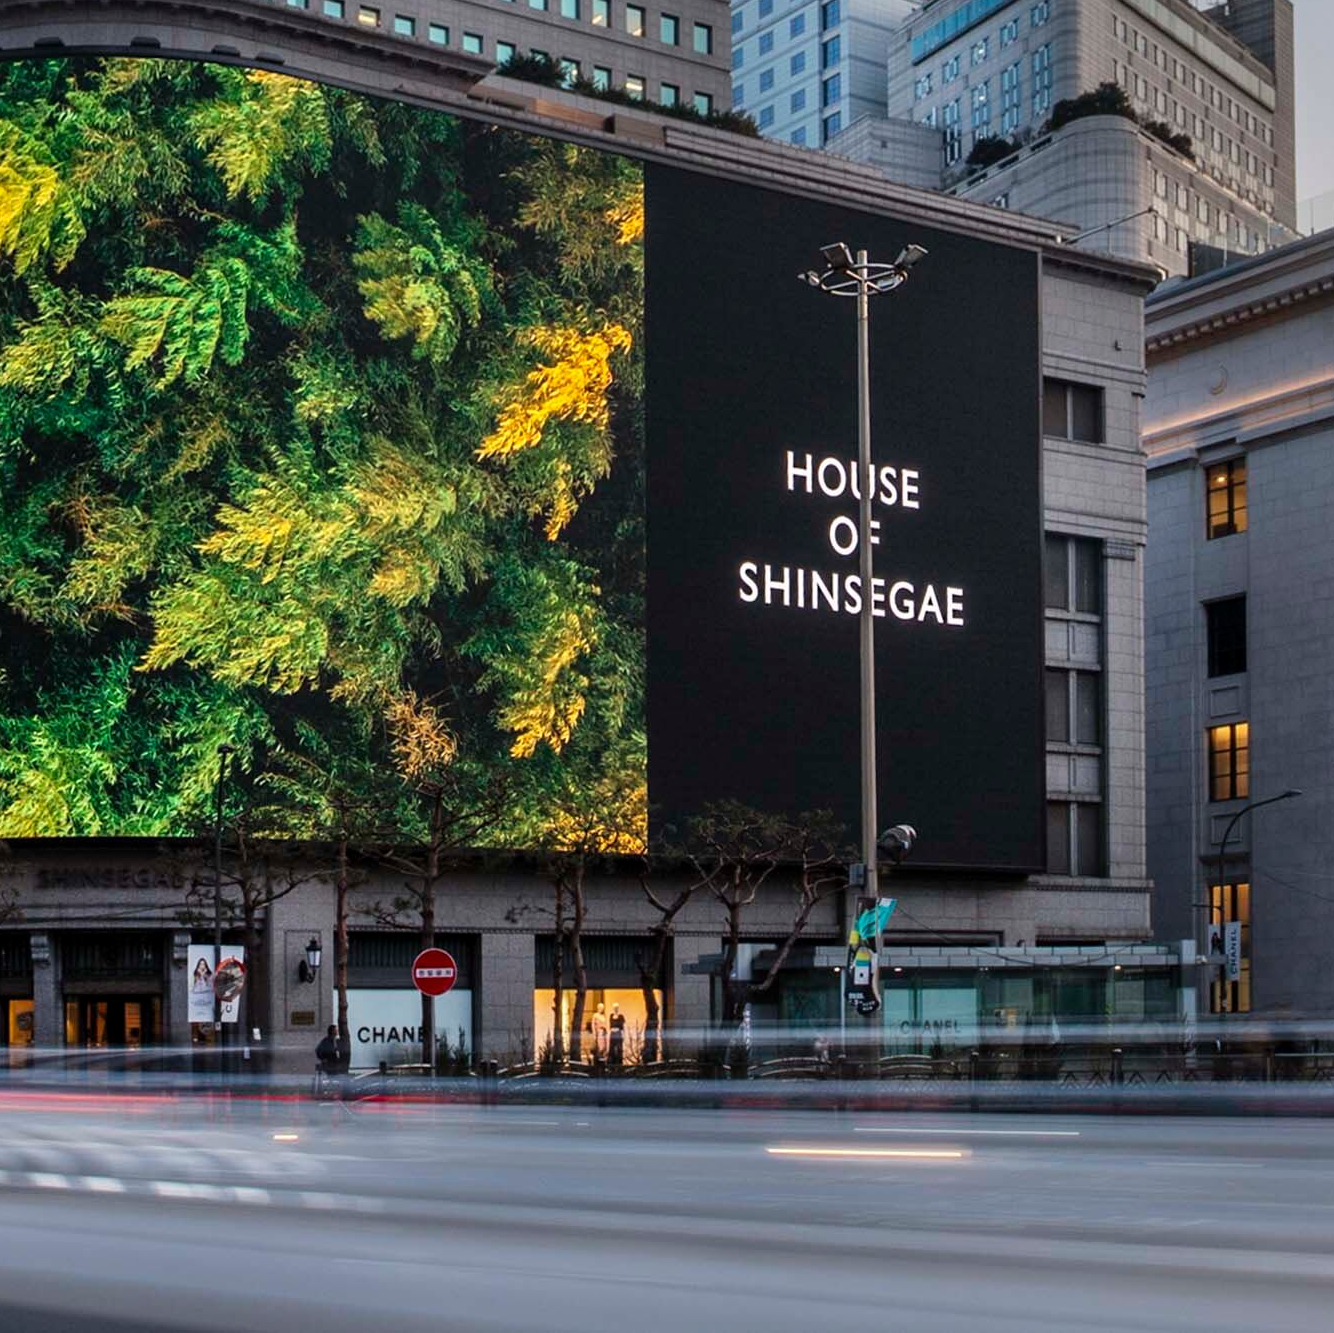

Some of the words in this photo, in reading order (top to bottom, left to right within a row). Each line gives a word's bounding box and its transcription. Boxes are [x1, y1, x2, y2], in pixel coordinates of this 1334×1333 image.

[786, 450, 920, 509] HOUSE
[739, 561, 965, 626] SHINSEGAE
[357, 1026, 426, 1043] CHANE
